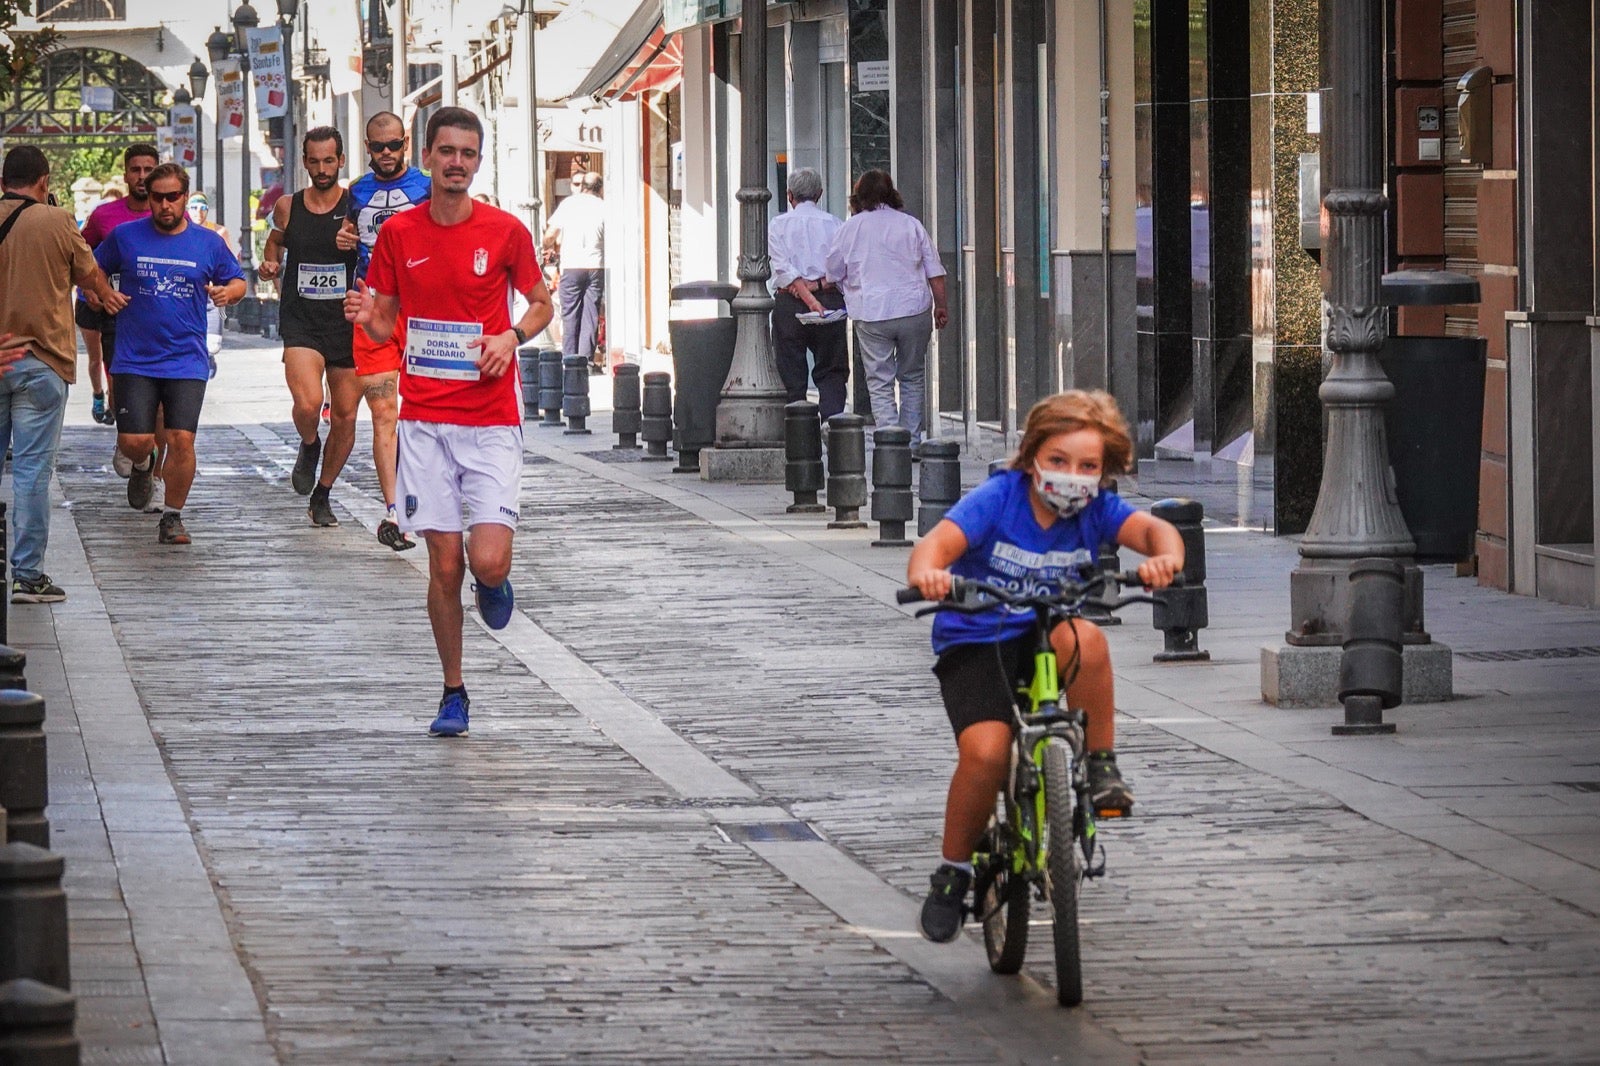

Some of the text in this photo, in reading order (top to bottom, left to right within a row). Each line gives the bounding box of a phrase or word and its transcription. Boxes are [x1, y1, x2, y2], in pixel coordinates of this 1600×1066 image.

[309, 275, 338, 287] 426
[427, 339, 460, 349] DORSAL
[421, 348, 466, 359] SOLIDARIO
